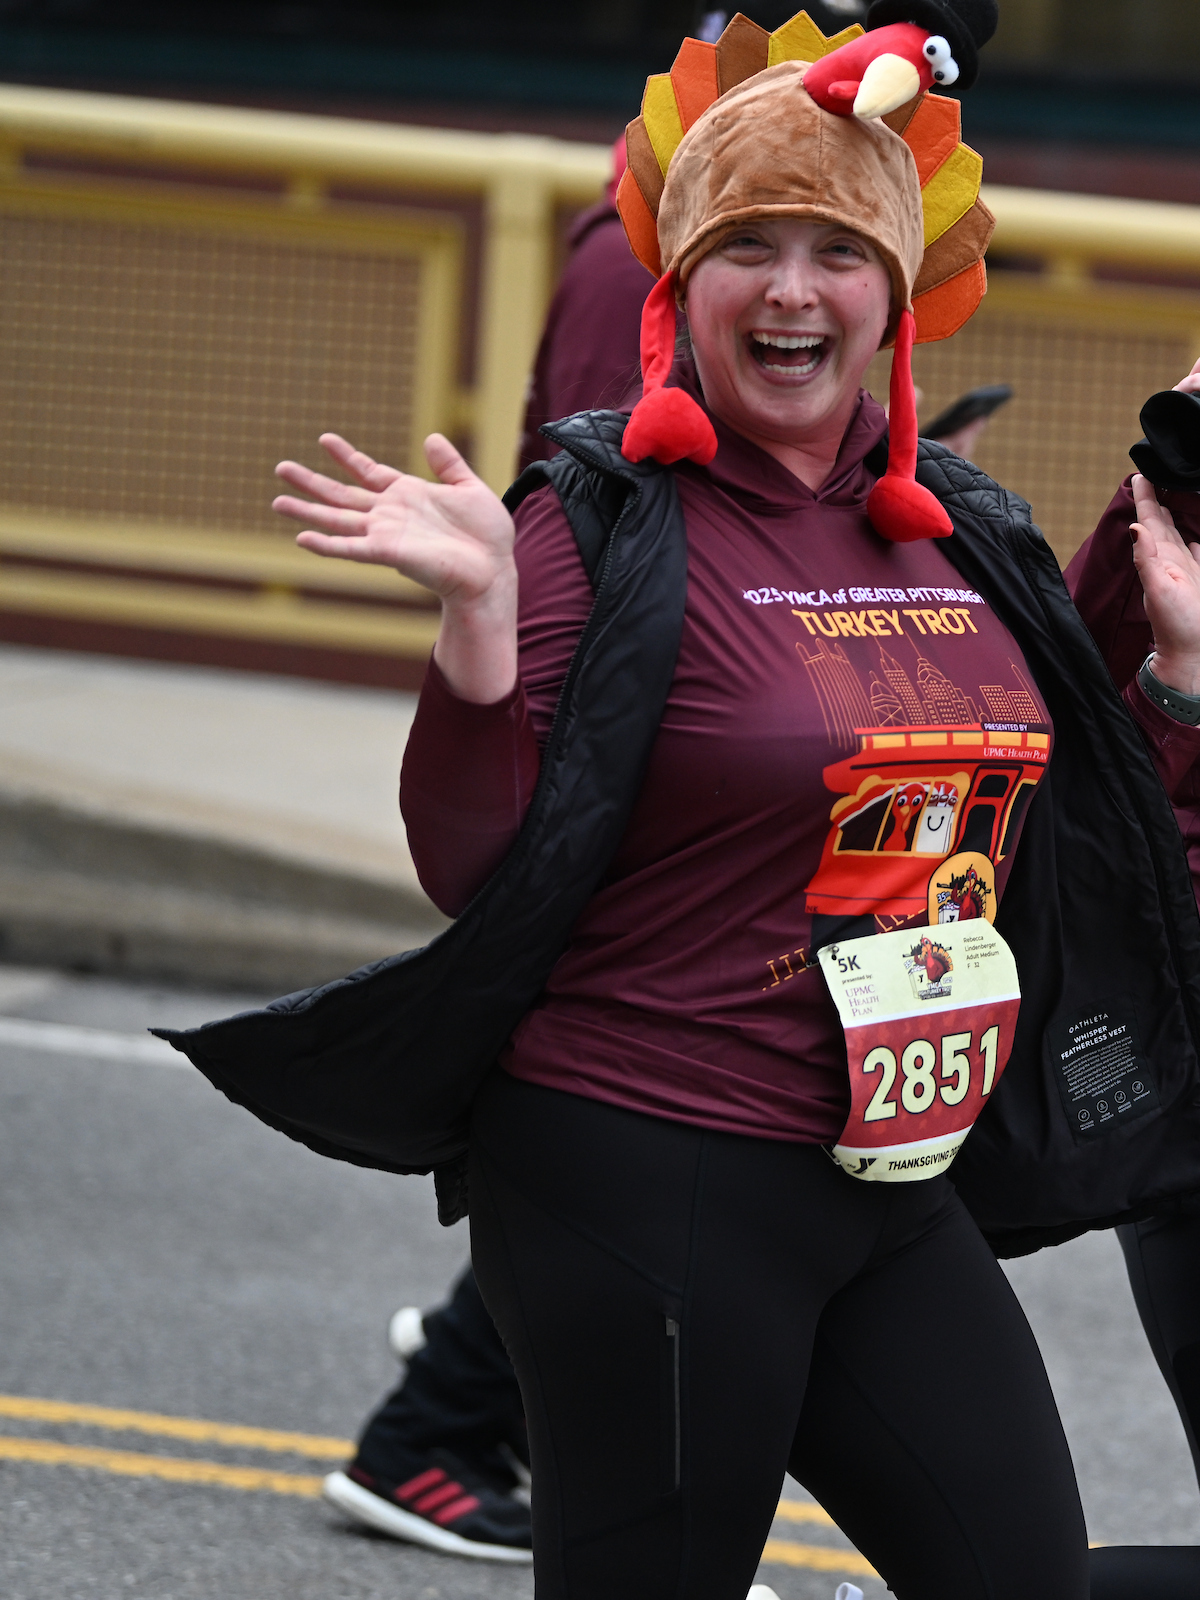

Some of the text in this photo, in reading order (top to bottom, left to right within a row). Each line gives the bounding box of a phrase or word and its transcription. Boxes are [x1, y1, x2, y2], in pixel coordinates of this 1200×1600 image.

[781, 589, 833, 606] YMCA
[832, 588, 848, 604] of
[848, 587, 910, 603] GREATER
[791, 607, 978, 637] TURKEY TROT
[984, 723, 1018, 731] PRESENTED
[983, 747, 1007, 757] UPMC
[963, 935, 984, 943] Rebecca
[965, 942, 997, 952] Lindenberger
[838, 955, 861, 973] 5K
[966, 950, 1000, 960] Adult Medium
[842, 975, 865, 985] presented
[845, 984, 876, 998] UPMC
[1074, 1013, 1109, 1031] ATHLETA
[1061, 1025, 1127, 1060] FEATHERLESS VEST
[1074, 1025, 1108, 1043] WHISPER
[862, 1024, 1000, 1123] 2851
[888, 1151, 950, 1171] THANKSGIVING
